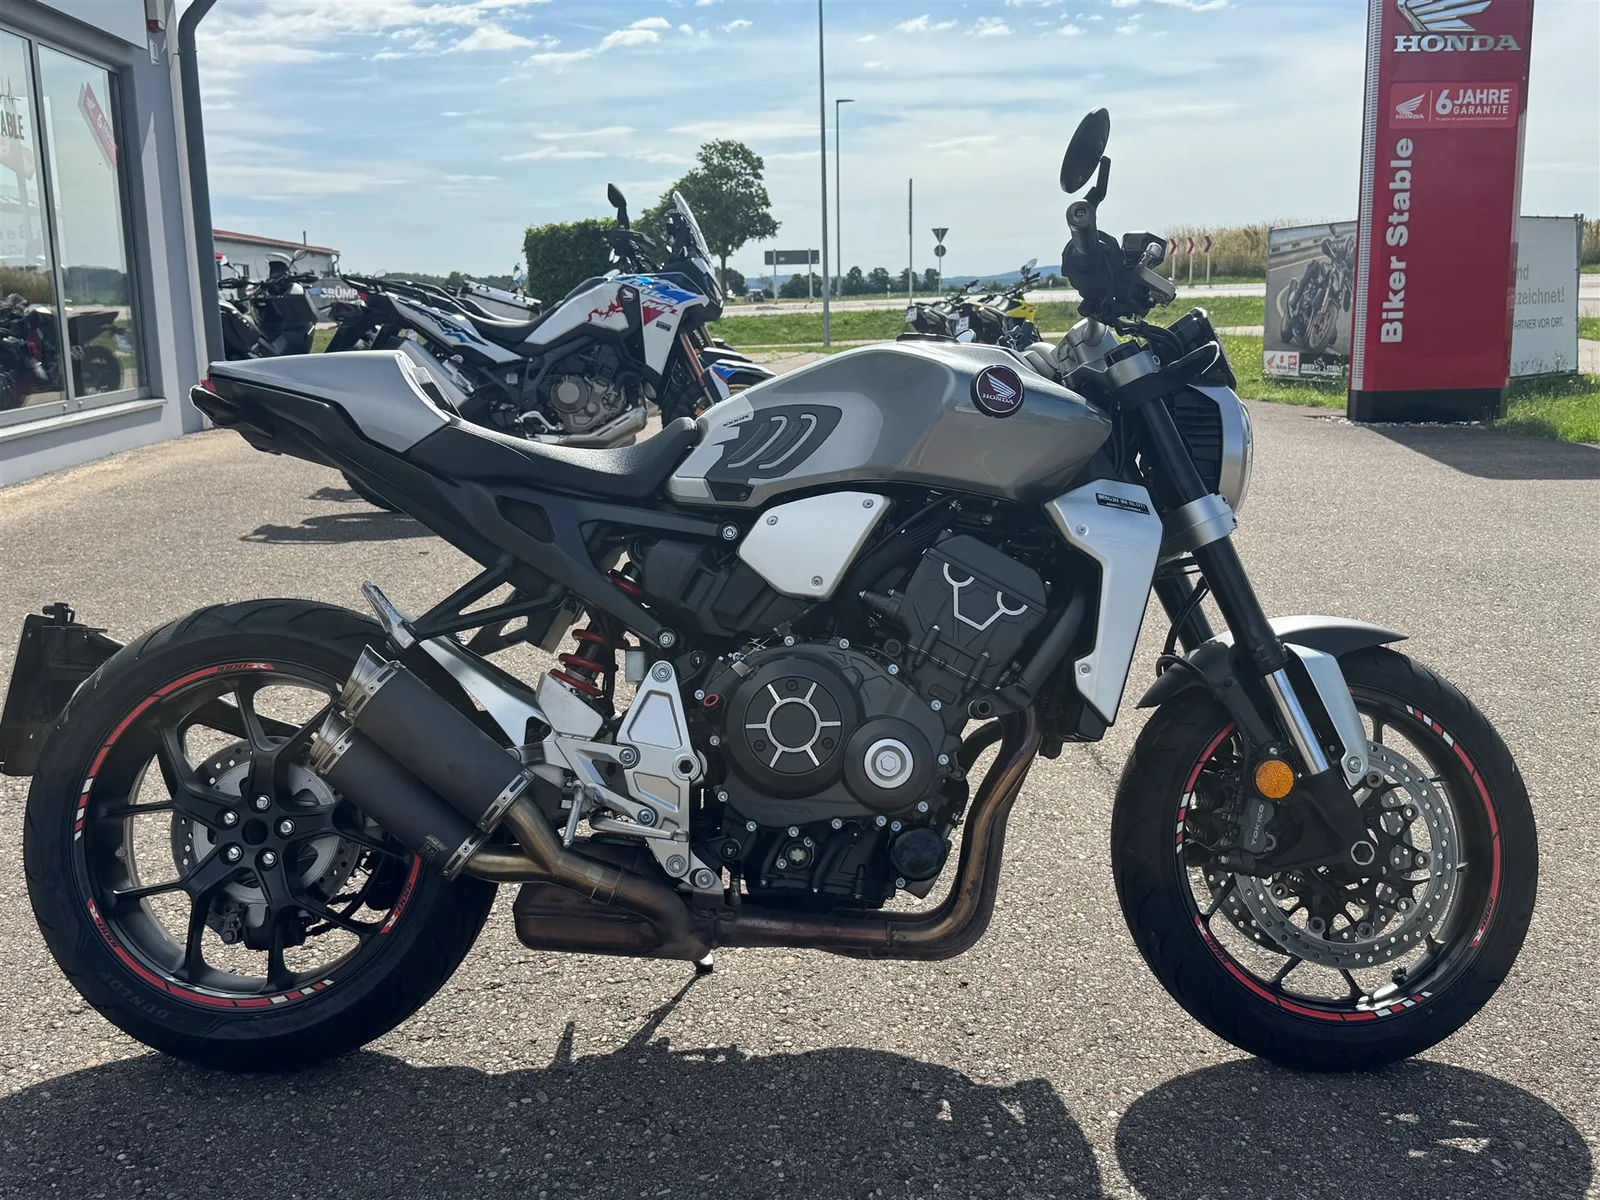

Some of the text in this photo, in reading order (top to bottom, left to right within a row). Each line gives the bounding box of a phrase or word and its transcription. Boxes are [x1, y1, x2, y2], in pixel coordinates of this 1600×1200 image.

[1393, 34, 1522, 53] HONDA
[1435, 89, 1453, 115] 6
[1453, 105, 1509, 115] GARANTIE
[1380, 137, 1413, 343] Biker Stable
[1515, 286, 1565, 305] zeichnet!
[1537, 317, 1550, 329] VOR
[982, 393, 1015, 405] HONDA
[1250, 804, 1265, 846] TOKICO
[98, 971, 172, 1020] DUNLOP
